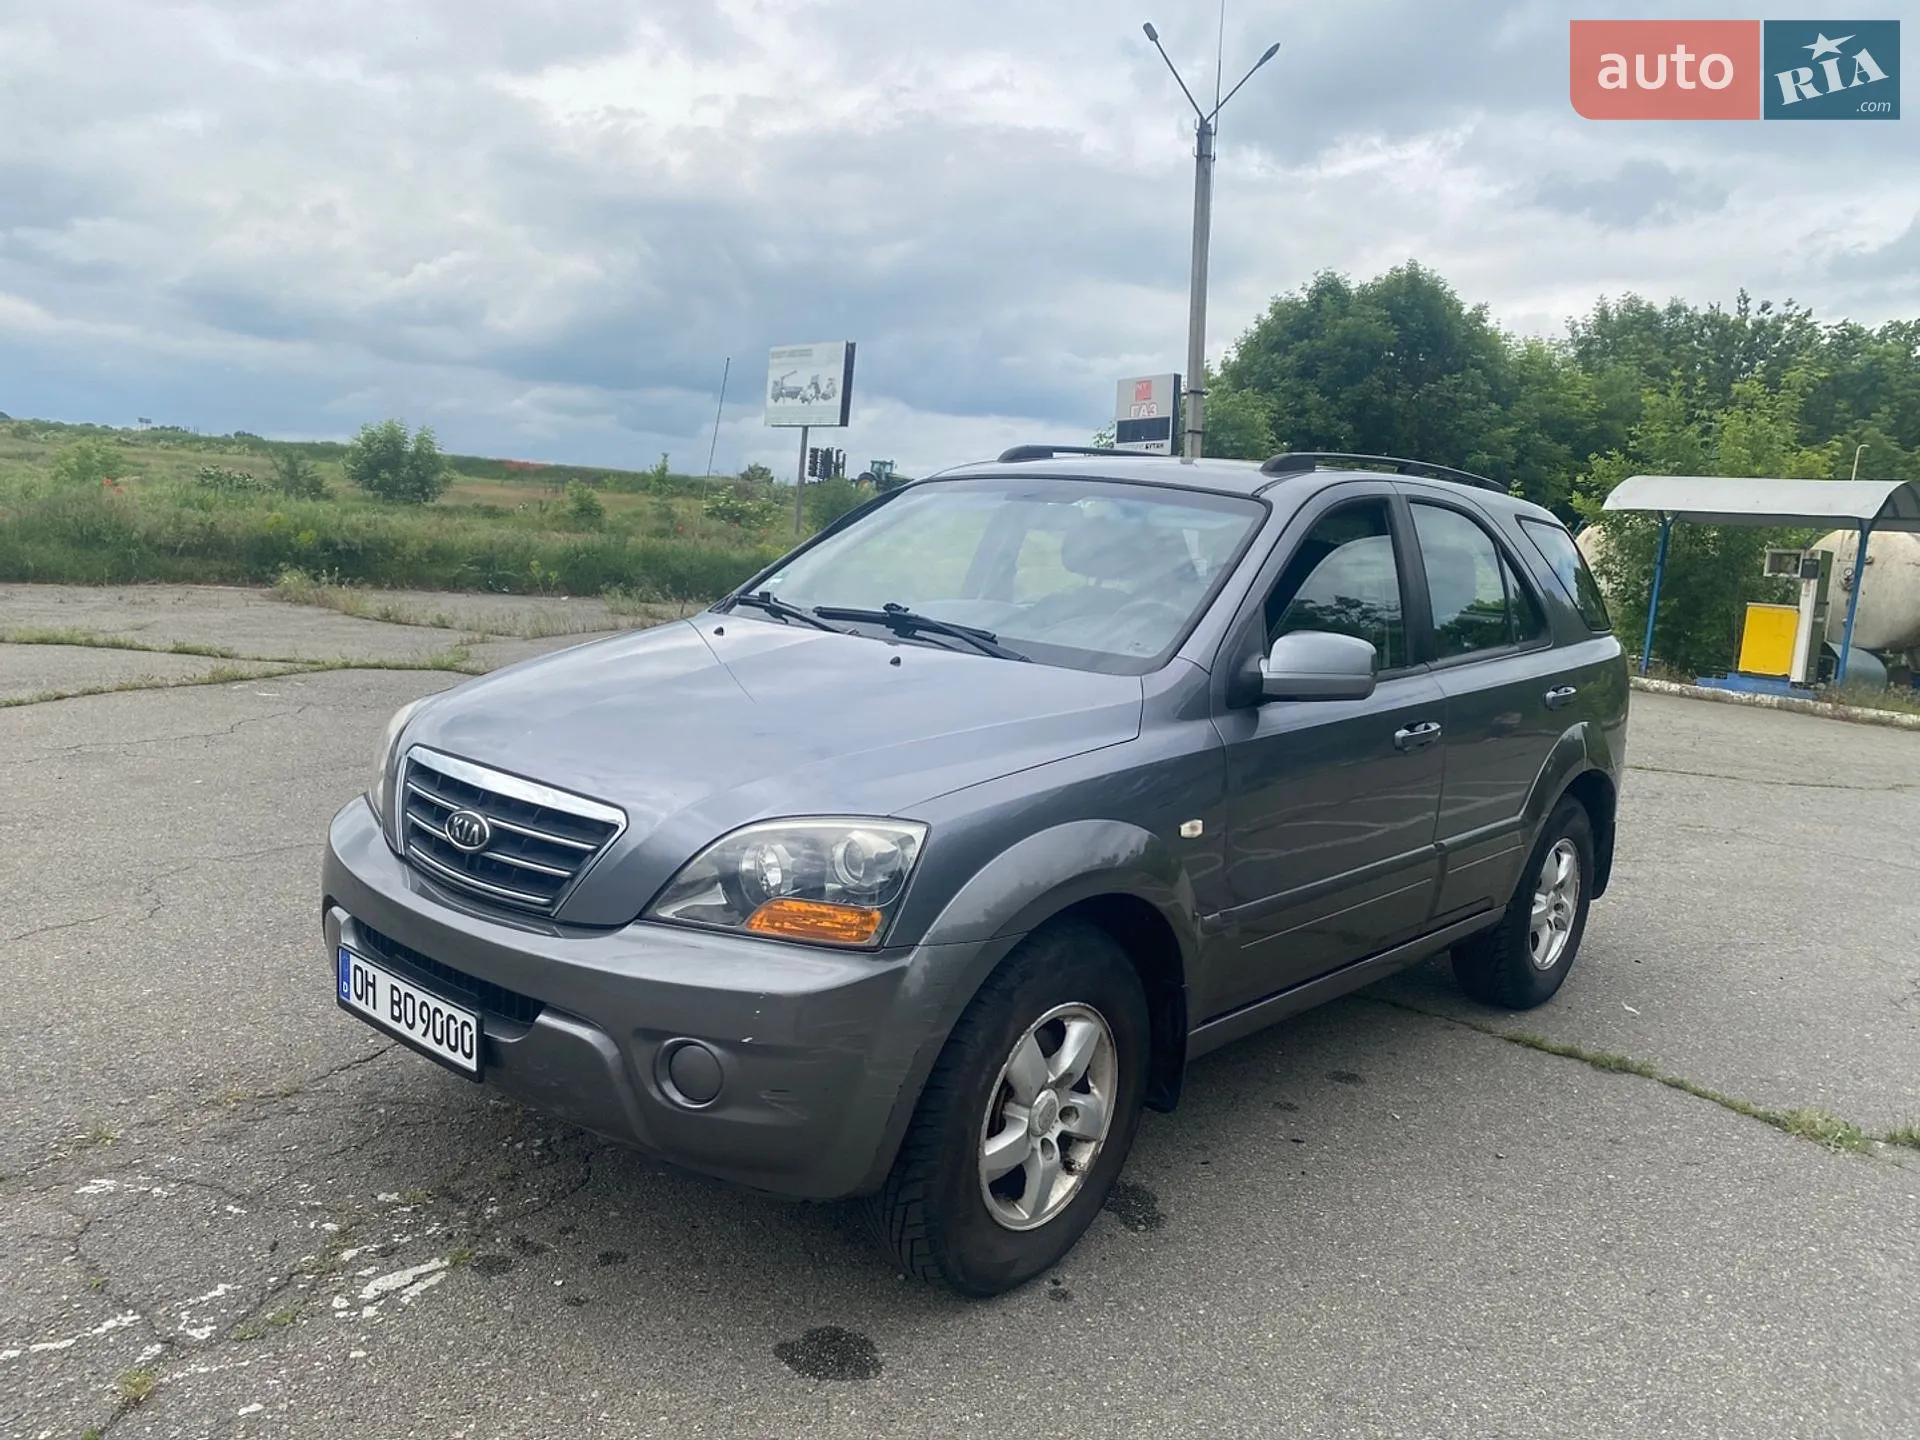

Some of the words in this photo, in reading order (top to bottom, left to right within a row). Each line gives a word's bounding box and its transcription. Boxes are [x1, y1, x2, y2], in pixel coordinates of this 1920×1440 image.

[1129, 402, 1158, 417] ГАЗ
[451, 816, 479, 845] KIA
[353, 964, 376, 1010] OH
